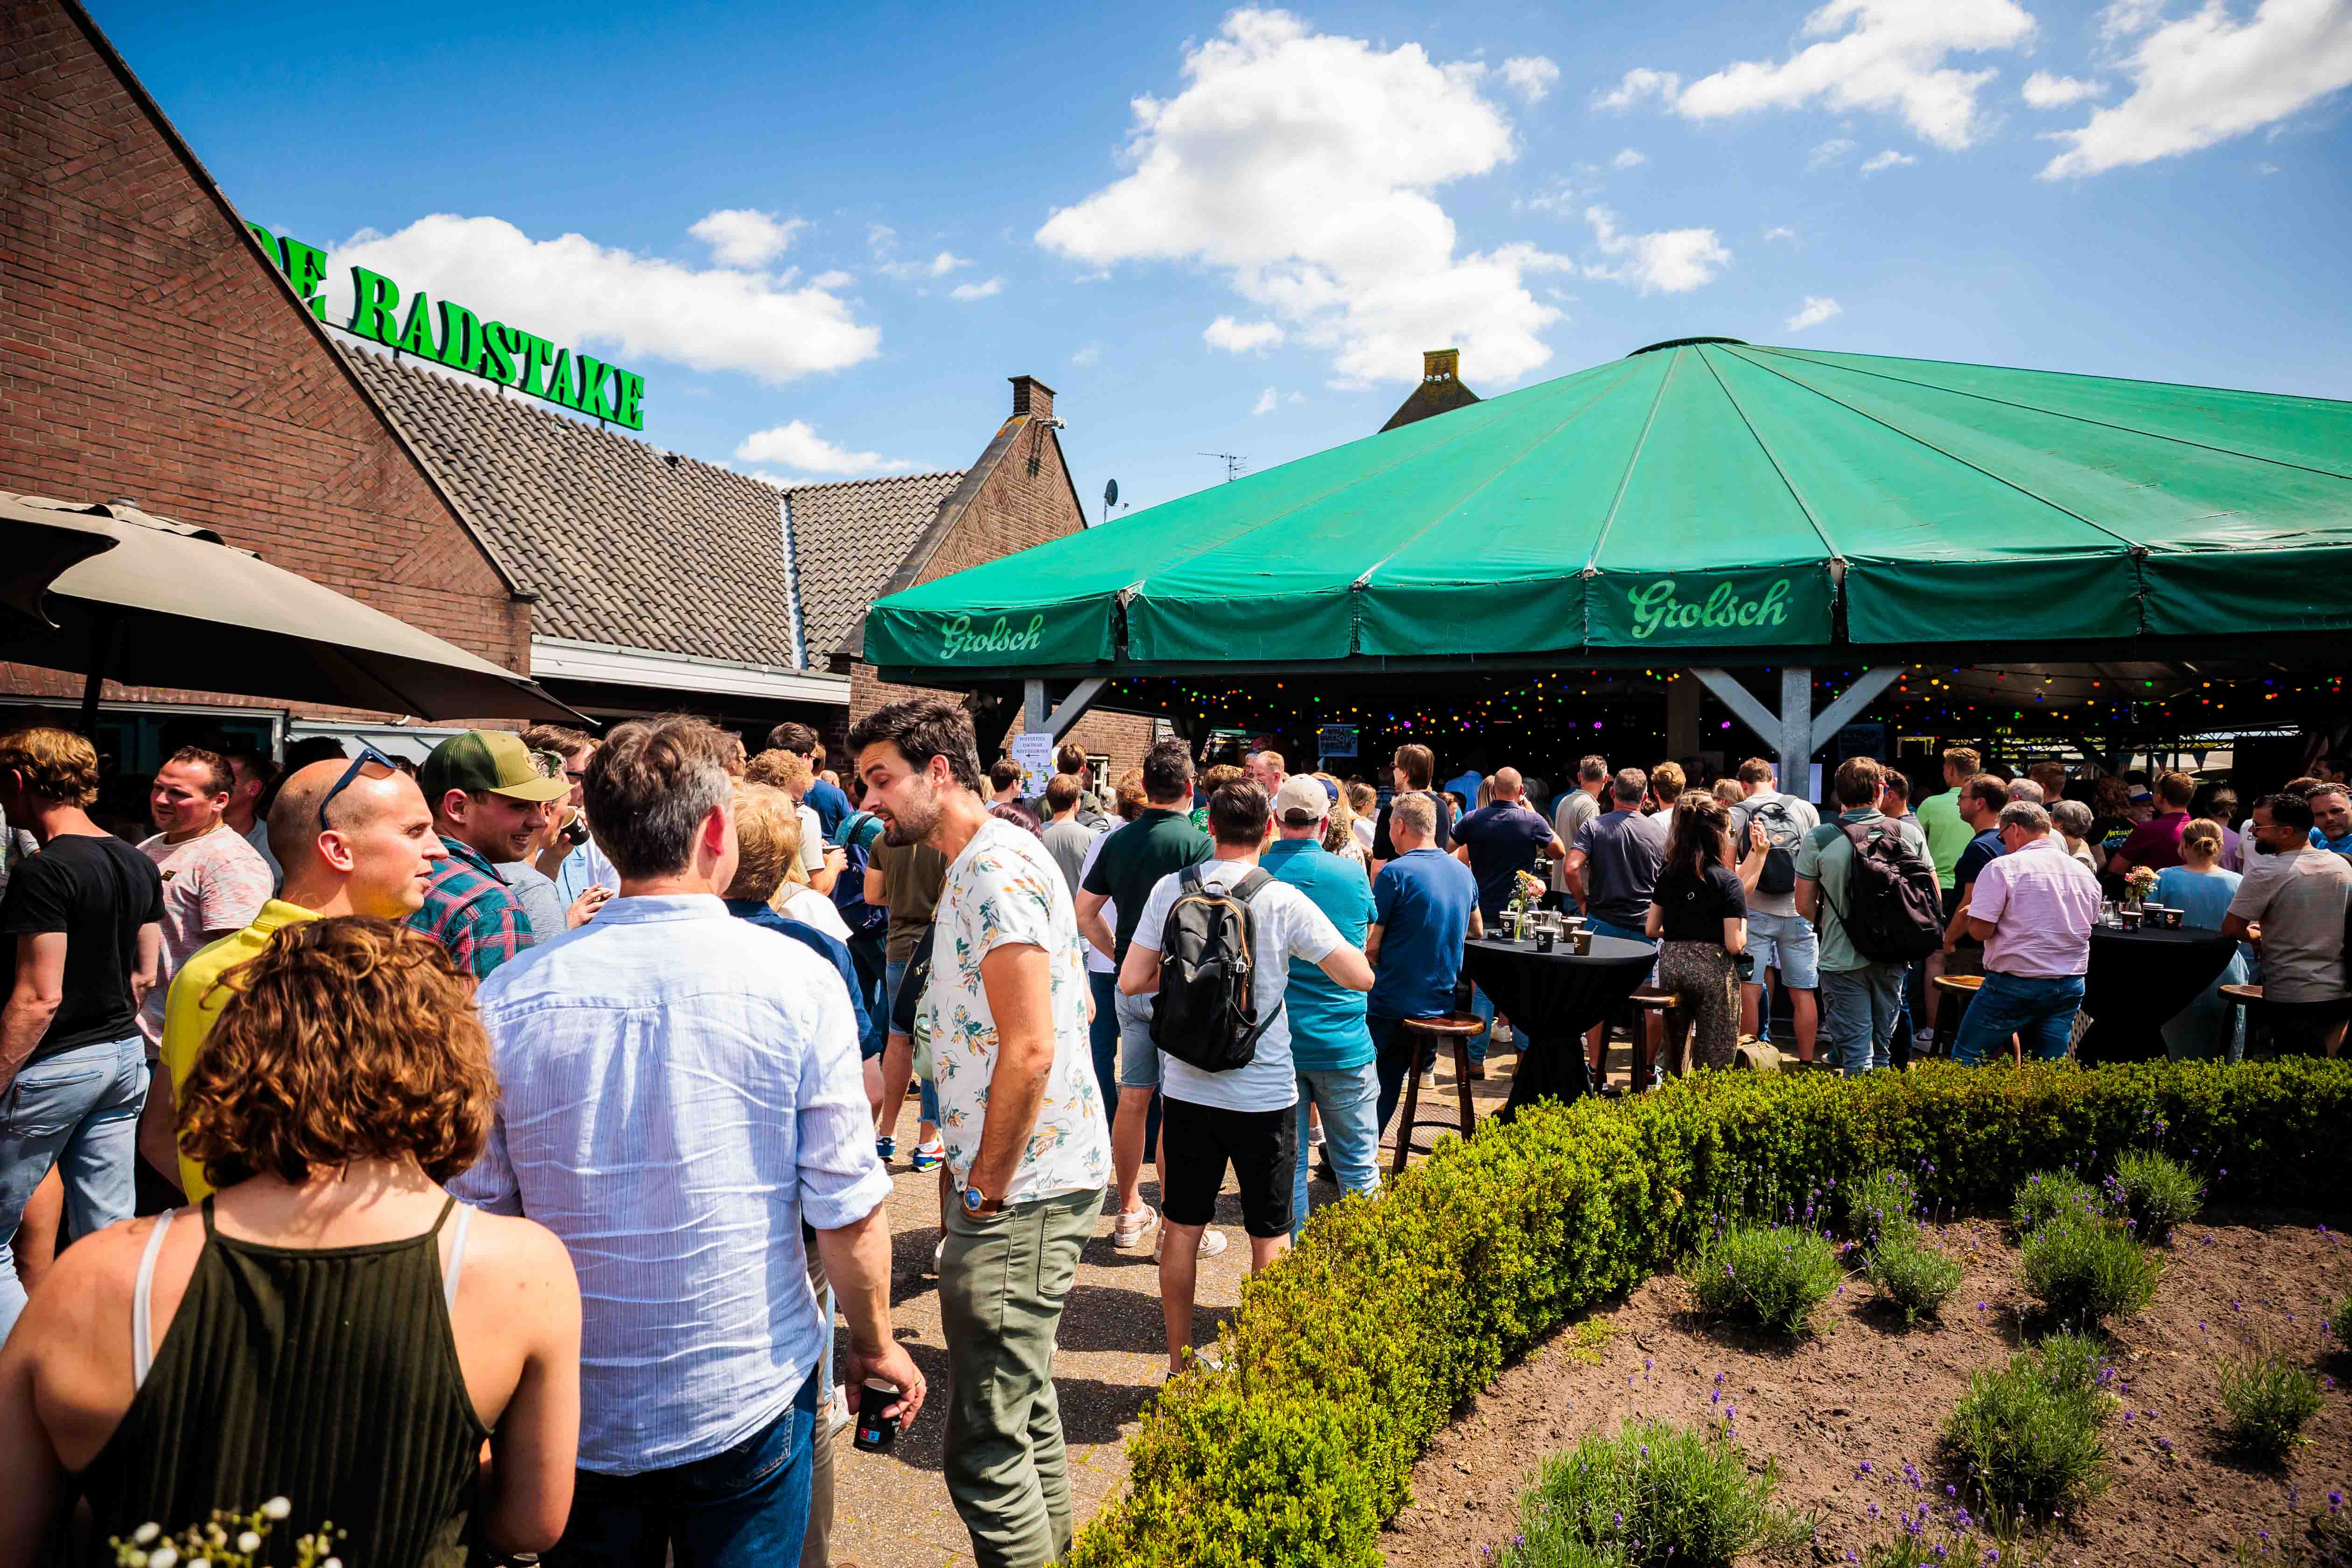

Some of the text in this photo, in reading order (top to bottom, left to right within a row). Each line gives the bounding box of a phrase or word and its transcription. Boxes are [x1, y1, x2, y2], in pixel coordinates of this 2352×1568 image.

[350, 265, 645, 431] RADSTAKE
[941, 614, 1044, 659] Grolsch
[1628, 579, 1790, 639] Grolsch
